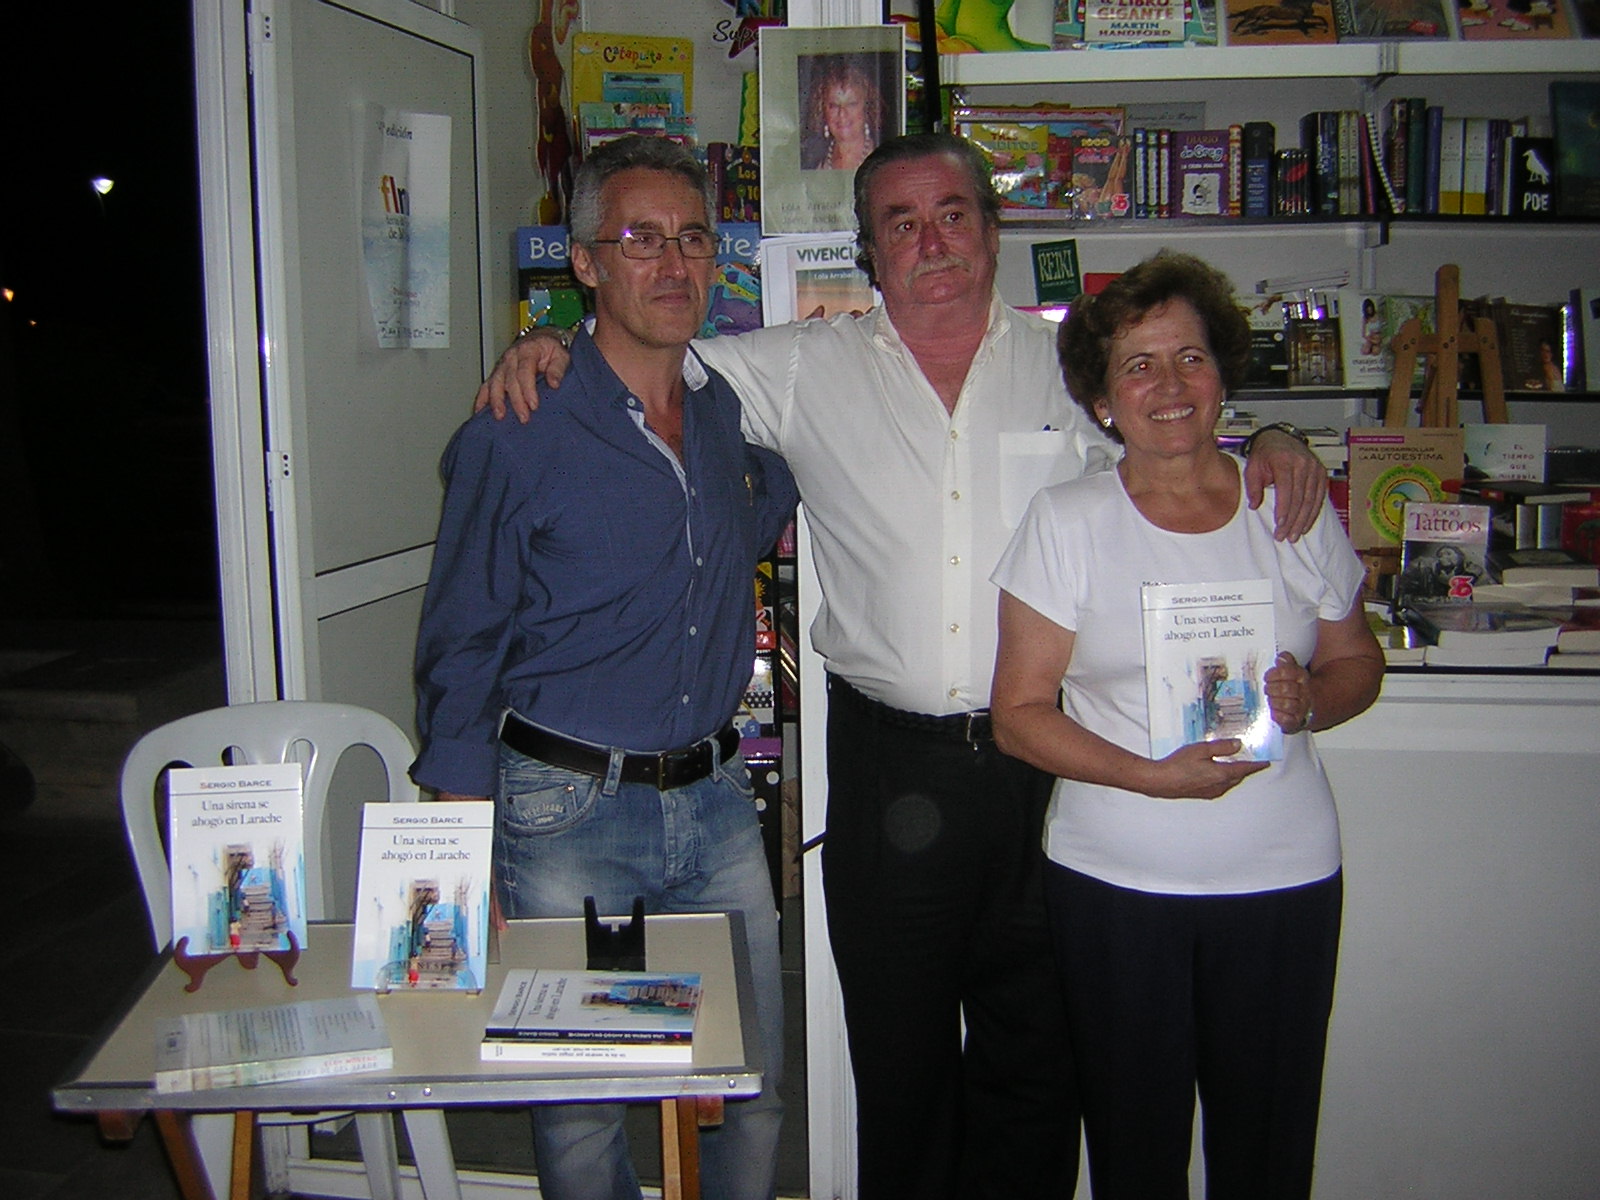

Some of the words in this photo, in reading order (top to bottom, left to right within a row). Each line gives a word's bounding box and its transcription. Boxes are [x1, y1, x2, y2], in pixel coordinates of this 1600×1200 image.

[1097, 7, 1174, 20] GIGANTE
[1110, 21, 1159, 30] MARTIN
[1098, 29, 1172, 37] HANDFORD
[1522, 192, 1549, 211] POE
[1037, 249, 1075, 282] REIKI
[1368, 452, 1444, 461] AUTOESTIMA
[1408, 511, 1481, 533] Tattoos
[1172, 595, 1208, 604] SERGIO
[1210, 594, 1244, 603] BARCE
[1174, 614, 1196, 626] Una
[1198, 614, 1229, 624] sirena
[1230, 614, 1242, 623] se
[1198, 630, 1211, 639] en
[1213, 625, 1255, 639] Larache
[200, 780, 236, 789] SERGIO
[238, 779, 272, 788] BARCE
[201, 800, 227, 812] Una
[229, 799, 255, 810] sirena
[257, 801, 269, 809] se
[192, 815, 224, 829] ahogó
[225, 817, 239, 826] en
[240, 813, 282, 825] Larache
[393, 816, 428, 825] SERGIO
[430, 816, 463, 825] BARCE
[393, 834, 418, 847] Una
[419, 835, 446, 846] sirena
[447, 838, 459, 846] se
[381, 850, 413, 863] ahogó
[414, 852, 427, 861] en
[428, 849, 471, 861] Larache
